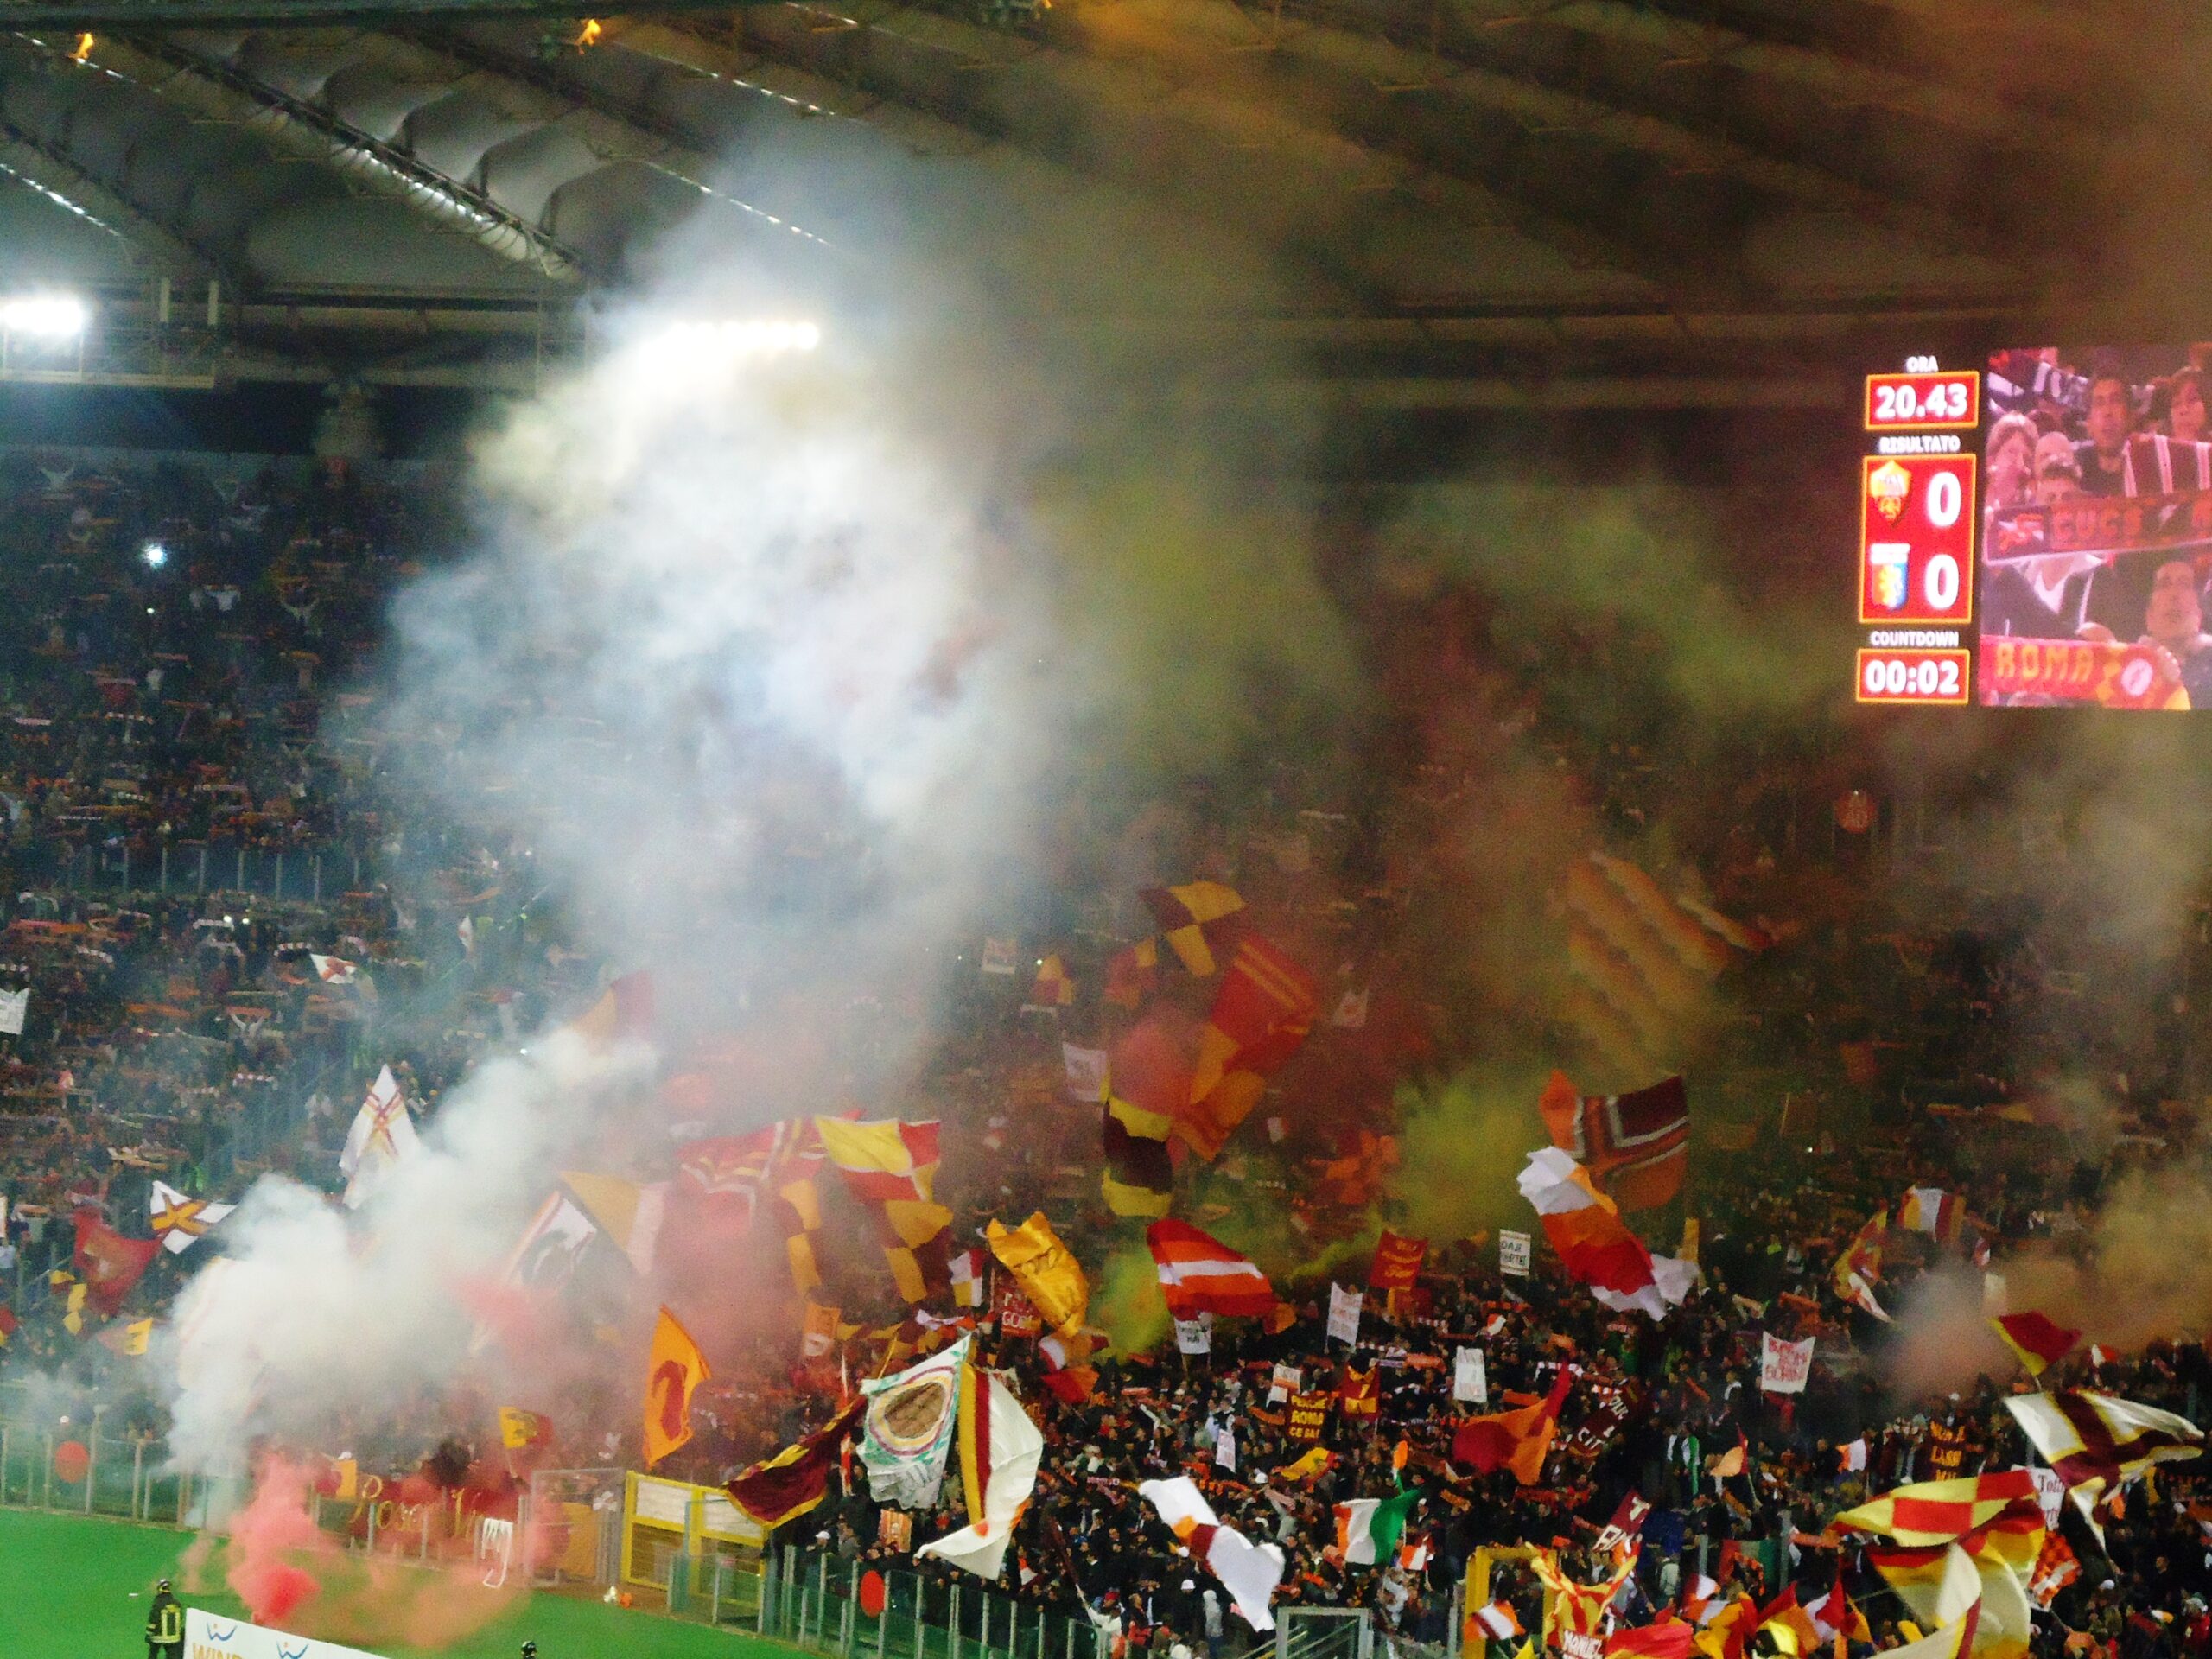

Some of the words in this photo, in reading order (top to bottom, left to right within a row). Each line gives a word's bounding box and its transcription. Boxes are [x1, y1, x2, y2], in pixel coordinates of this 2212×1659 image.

[1905, 355, 1939, 372] ORA
[1875, 383, 1967, 418] 20.43
[1878, 435, 1961, 454] RISULTATO
[1927, 471, 1961, 528] 0
[1924, 554, 1960, 609] 0
[1869, 630, 1960, 647] COUNTDOWN
[1866, 659, 1960, 695] 00:02
